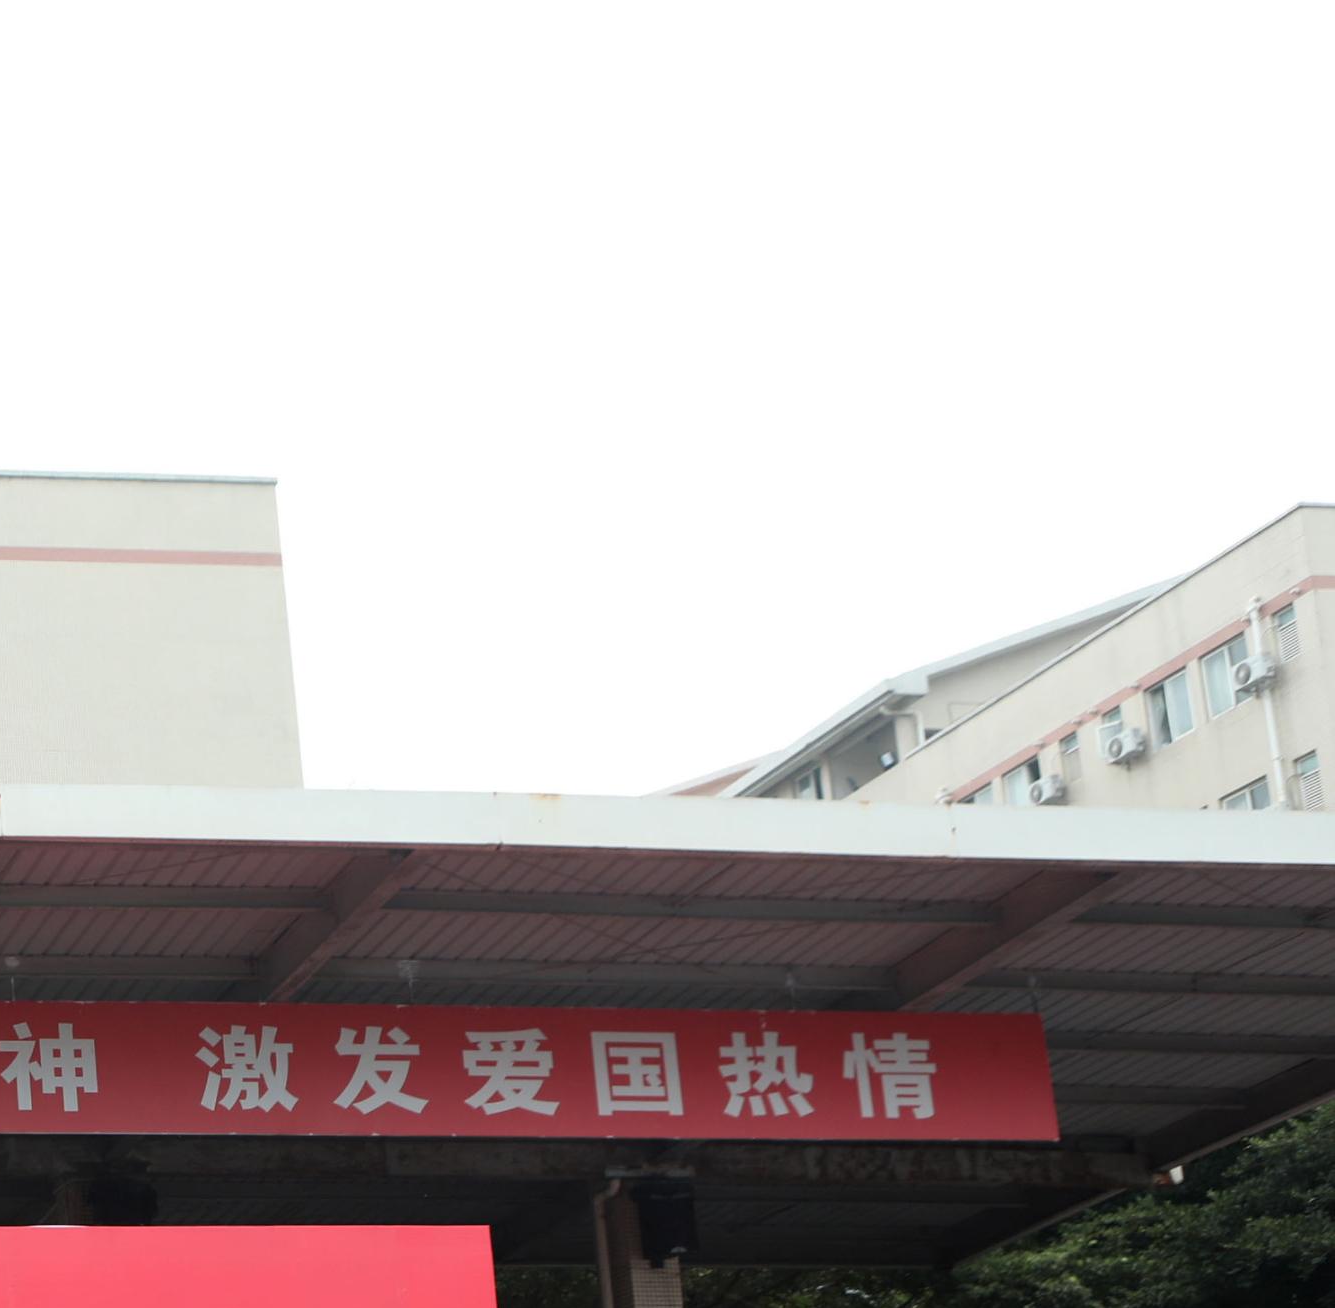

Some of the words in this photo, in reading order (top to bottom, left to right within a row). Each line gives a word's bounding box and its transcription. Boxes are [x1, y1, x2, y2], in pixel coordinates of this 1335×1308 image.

[195, 1024, 936, 1120] 激发爱国热情
